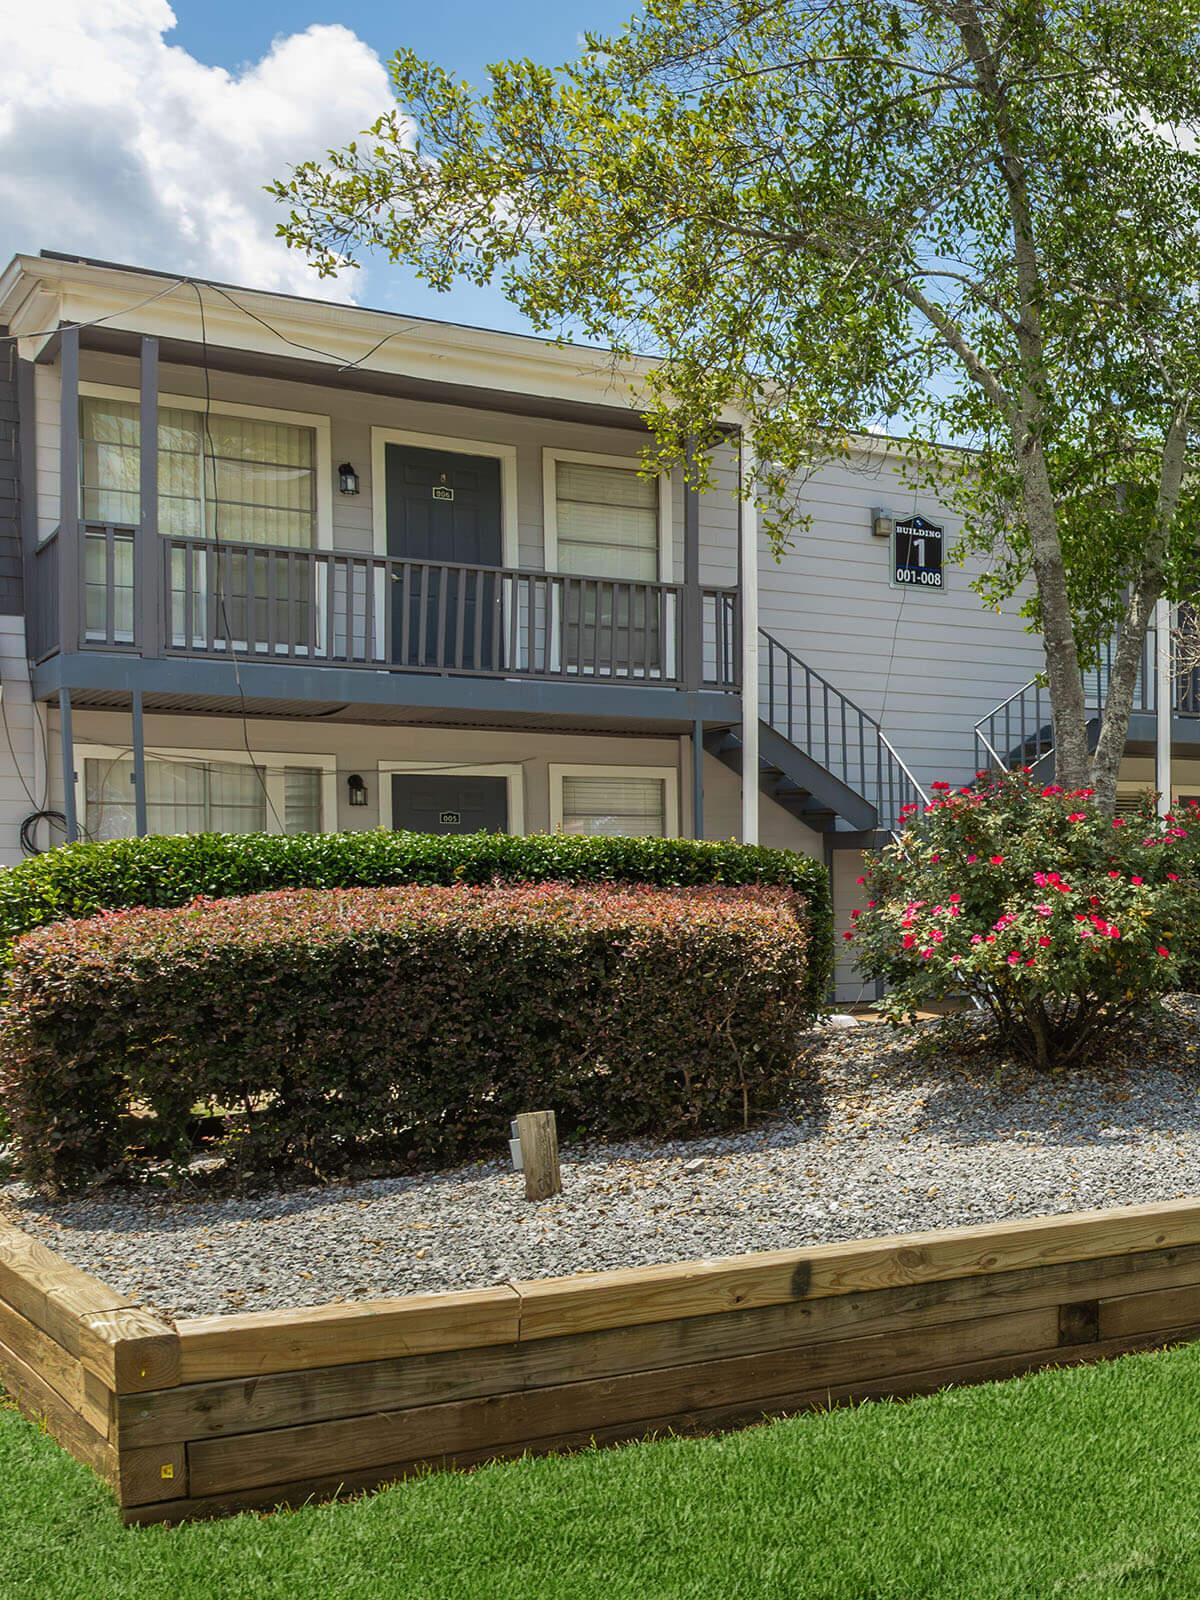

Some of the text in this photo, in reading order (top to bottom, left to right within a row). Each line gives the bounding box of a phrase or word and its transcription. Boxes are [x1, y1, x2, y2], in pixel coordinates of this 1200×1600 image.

[896, 526, 941, 538] BUILDING
[913, 539, 925, 567] 1
[896, 569, 941, 585] 001-008
